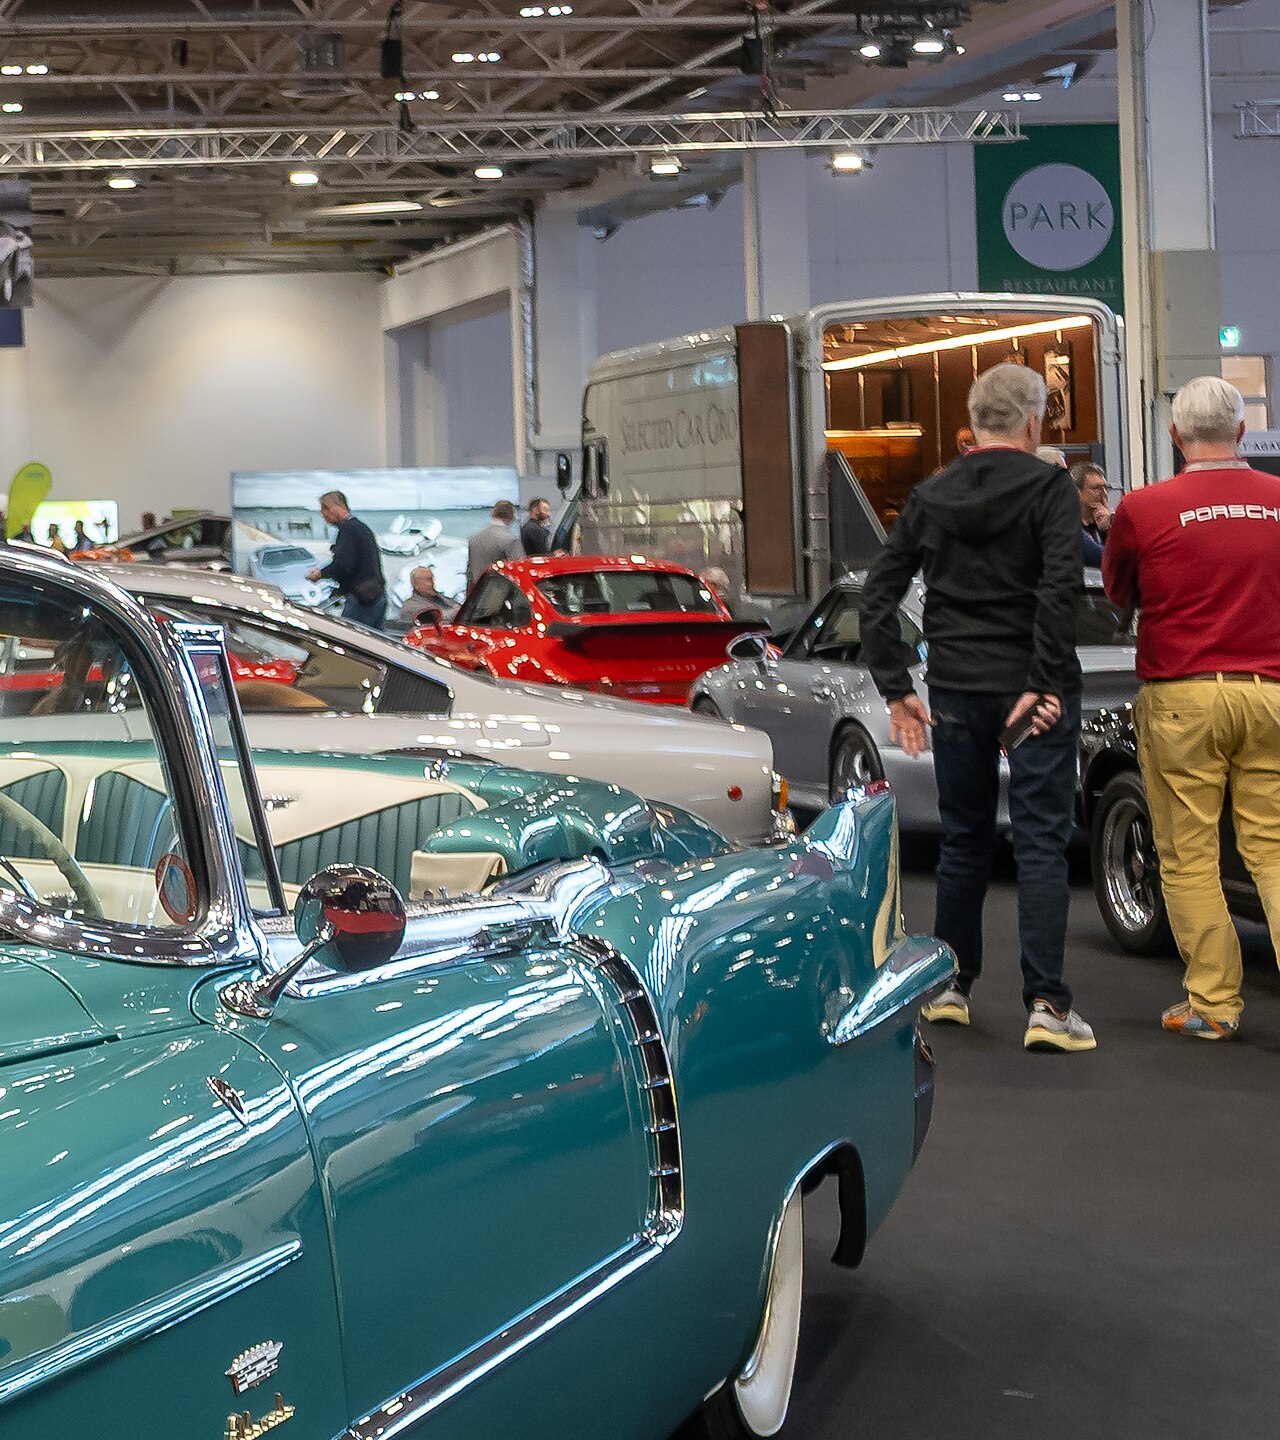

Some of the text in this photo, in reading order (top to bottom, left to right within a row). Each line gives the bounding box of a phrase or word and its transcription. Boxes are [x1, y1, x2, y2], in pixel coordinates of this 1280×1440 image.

[1010, 201, 1107, 231] PARK
[1003, 279, 1116, 292] RESTAURANT
[1179, 504, 1280, 527] PORSCH
